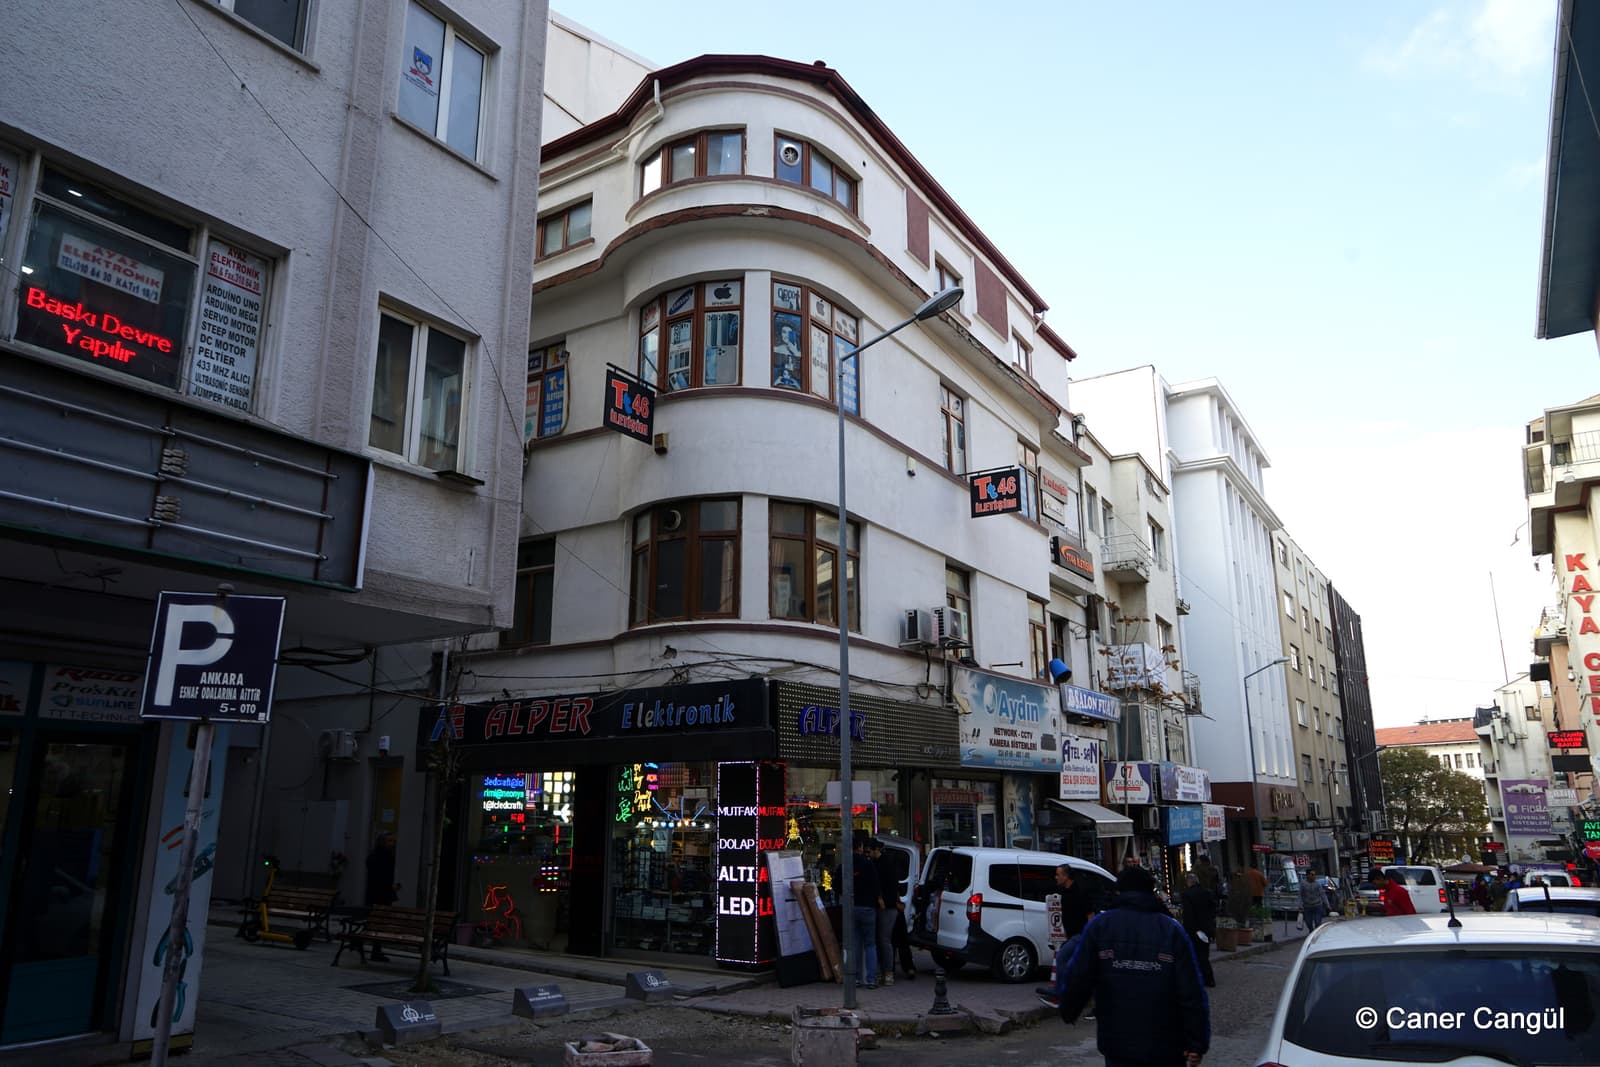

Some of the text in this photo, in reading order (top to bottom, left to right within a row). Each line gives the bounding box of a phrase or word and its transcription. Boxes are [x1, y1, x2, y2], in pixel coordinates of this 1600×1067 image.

[93, 246, 138, 269] AYAZ
[243, 297, 260, 311] UNO
[26, 286, 173, 353] Baskı Devre
[203, 308, 257, 336] SERVO MOTOR
[238, 308, 259, 324] MEGA
[201, 320, 255, 348] STEEP MOTOR
[199, 333, 246, 358] DC MOTOR
[198, 346, 235, 367] PELTİER
[196, 359, 251, 385] 433 MHZ ALICI
[154, 603, 236, 706] P
[200, 671, 244, 686] ANKARA
[179, 686, 200, 699] ESNAF
[201, 686, 238, 701] ODALARINA
[240, 703, 257, 715] OTO
[484, 697, 596, 741] ALPER
[621, 694, 737, 730] Elektronik
[998, 690, 1039, 725] Aydın
[802, 705, 866, 741] ALPR
[993, 727, 1018, 738] NETWORK
[989, 738, 1010, 749] KAMERA
[718, 806, 786, 817] MUTFAK MUTFAK
[719, 838, 785, 850] DOLAP DOLAP
[718, 866, 756, 882] ALTI
[719, 896, 755, 916] LED
